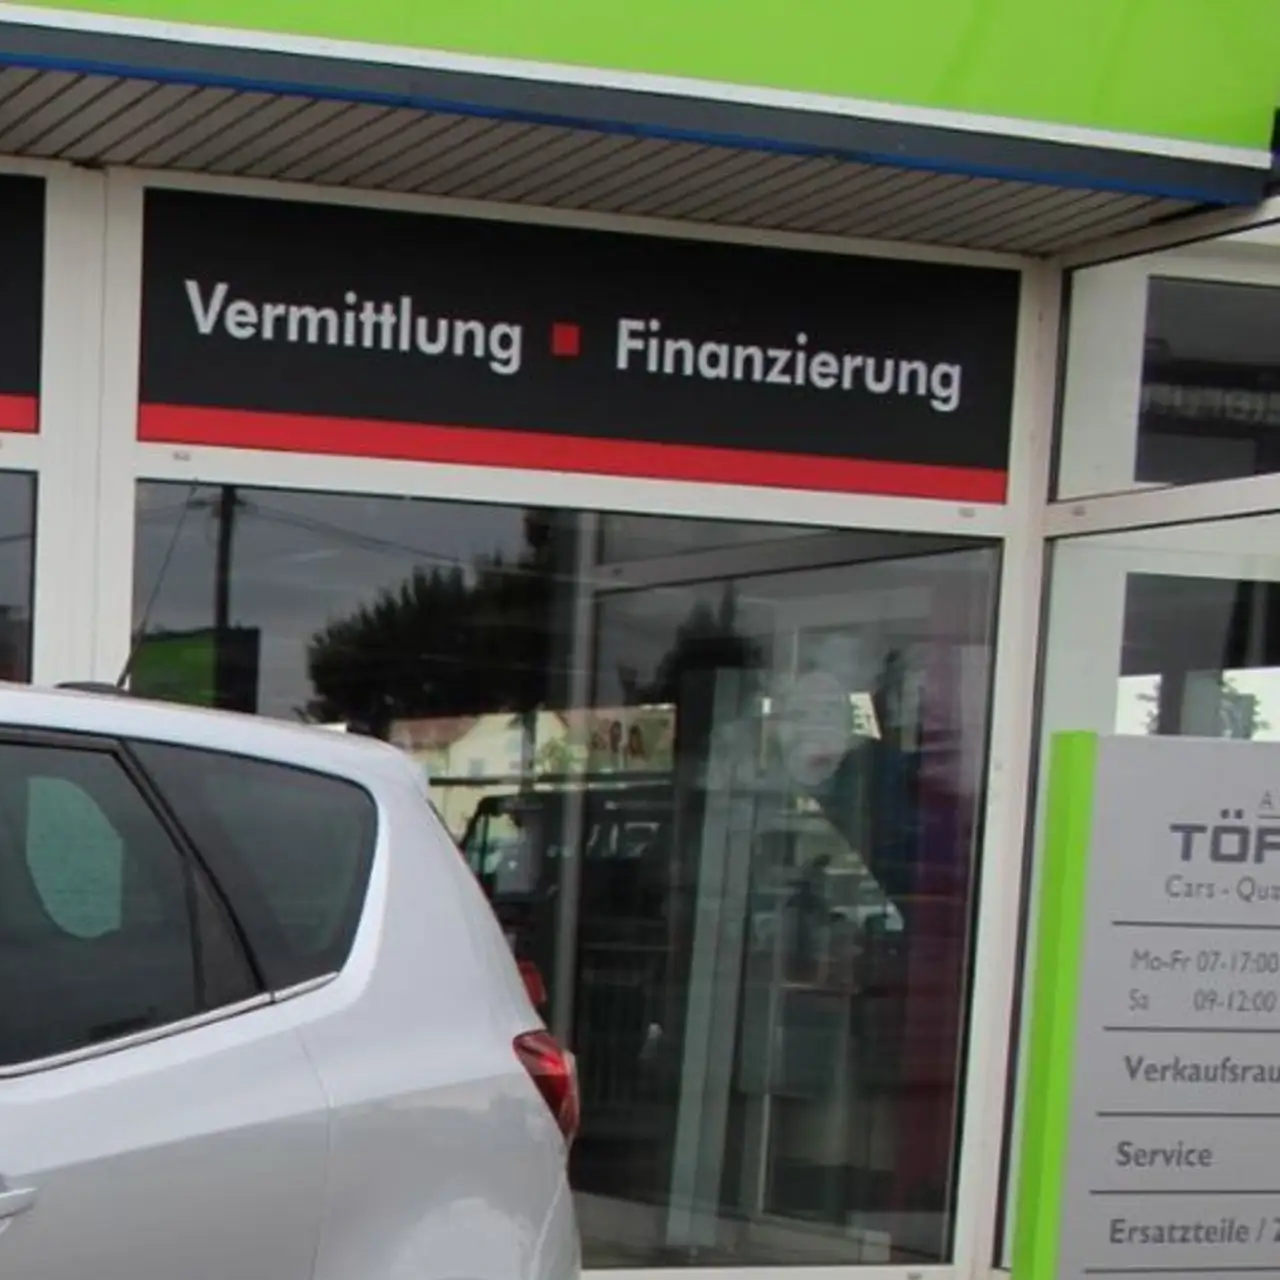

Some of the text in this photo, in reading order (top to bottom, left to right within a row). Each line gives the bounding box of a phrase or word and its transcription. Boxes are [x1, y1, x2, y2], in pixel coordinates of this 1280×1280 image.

[185, 280, 962, 412] Vermittlung Finanzierung
[1165, 874, 1216, 899] Cars
[1130, 949, 1192, 971] Mo-Fr
[1128, 988, 1149, 1011] Sa
[1115, 1140, 1214, 1168] Service
[1109, 1218, 1250, 1245] Ersatzteile
